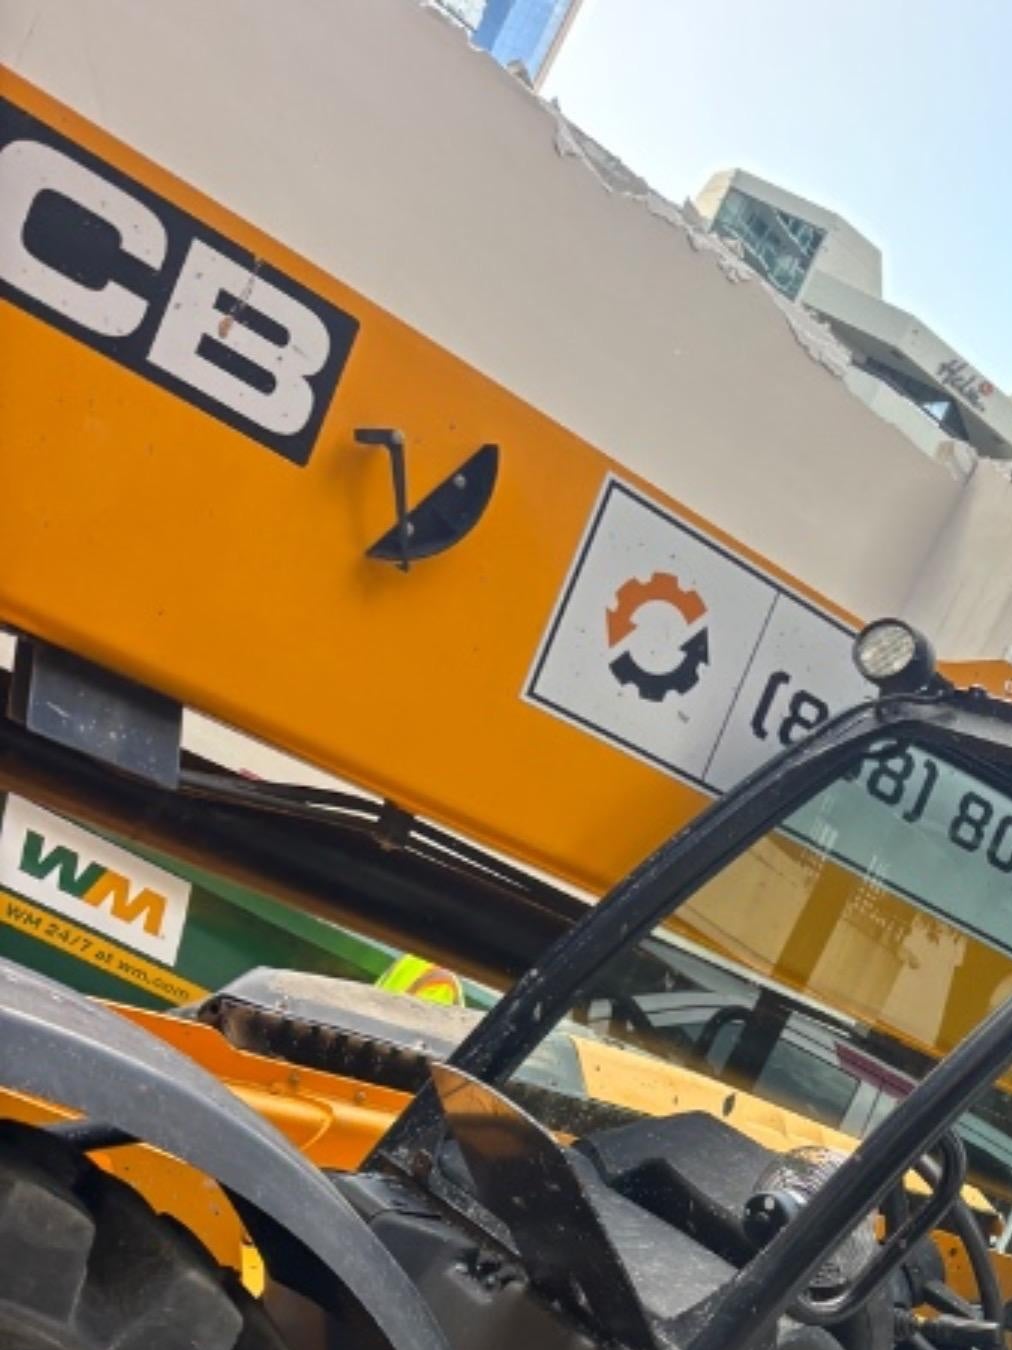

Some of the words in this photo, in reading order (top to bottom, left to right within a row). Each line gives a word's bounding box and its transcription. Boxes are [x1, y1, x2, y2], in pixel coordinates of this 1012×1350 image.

[19, 828, 168, 937] WM
[6, 902, 43, 929] WM
[44, 922, 94, 953] 24/7
[94, 948, 115, 965] at
[118, 961, 190, 1001] wm.com
